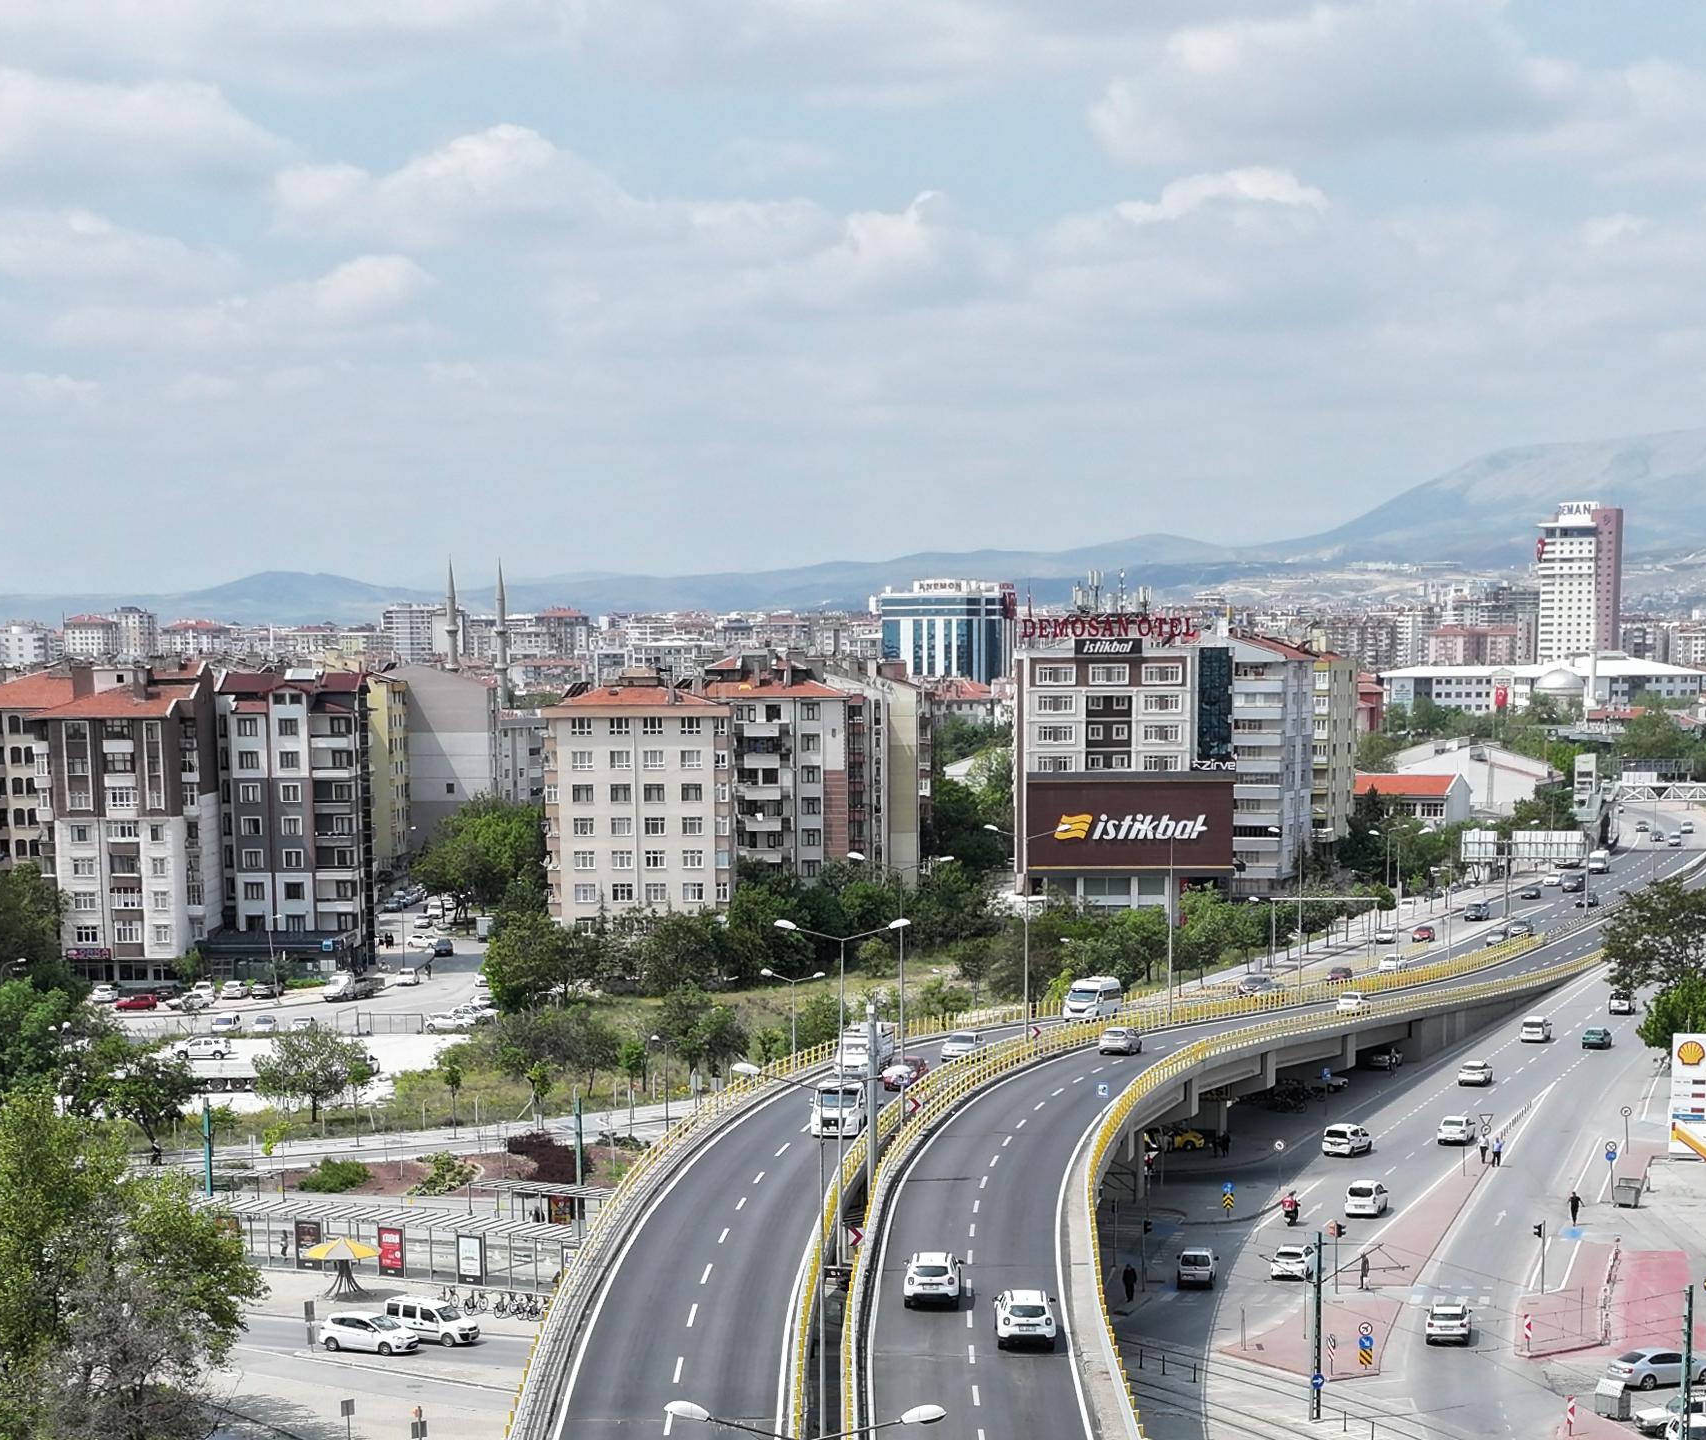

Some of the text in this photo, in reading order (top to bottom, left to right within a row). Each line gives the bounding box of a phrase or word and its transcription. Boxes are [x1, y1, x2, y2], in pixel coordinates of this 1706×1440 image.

[918, 582, 962, 593] ANEMON
[1021, 616, 1197, 638] DEMOSAN OTEL
[1082, 640, 1133, 654] istikbal
[1092, 813, 1207, 841] istikbal
